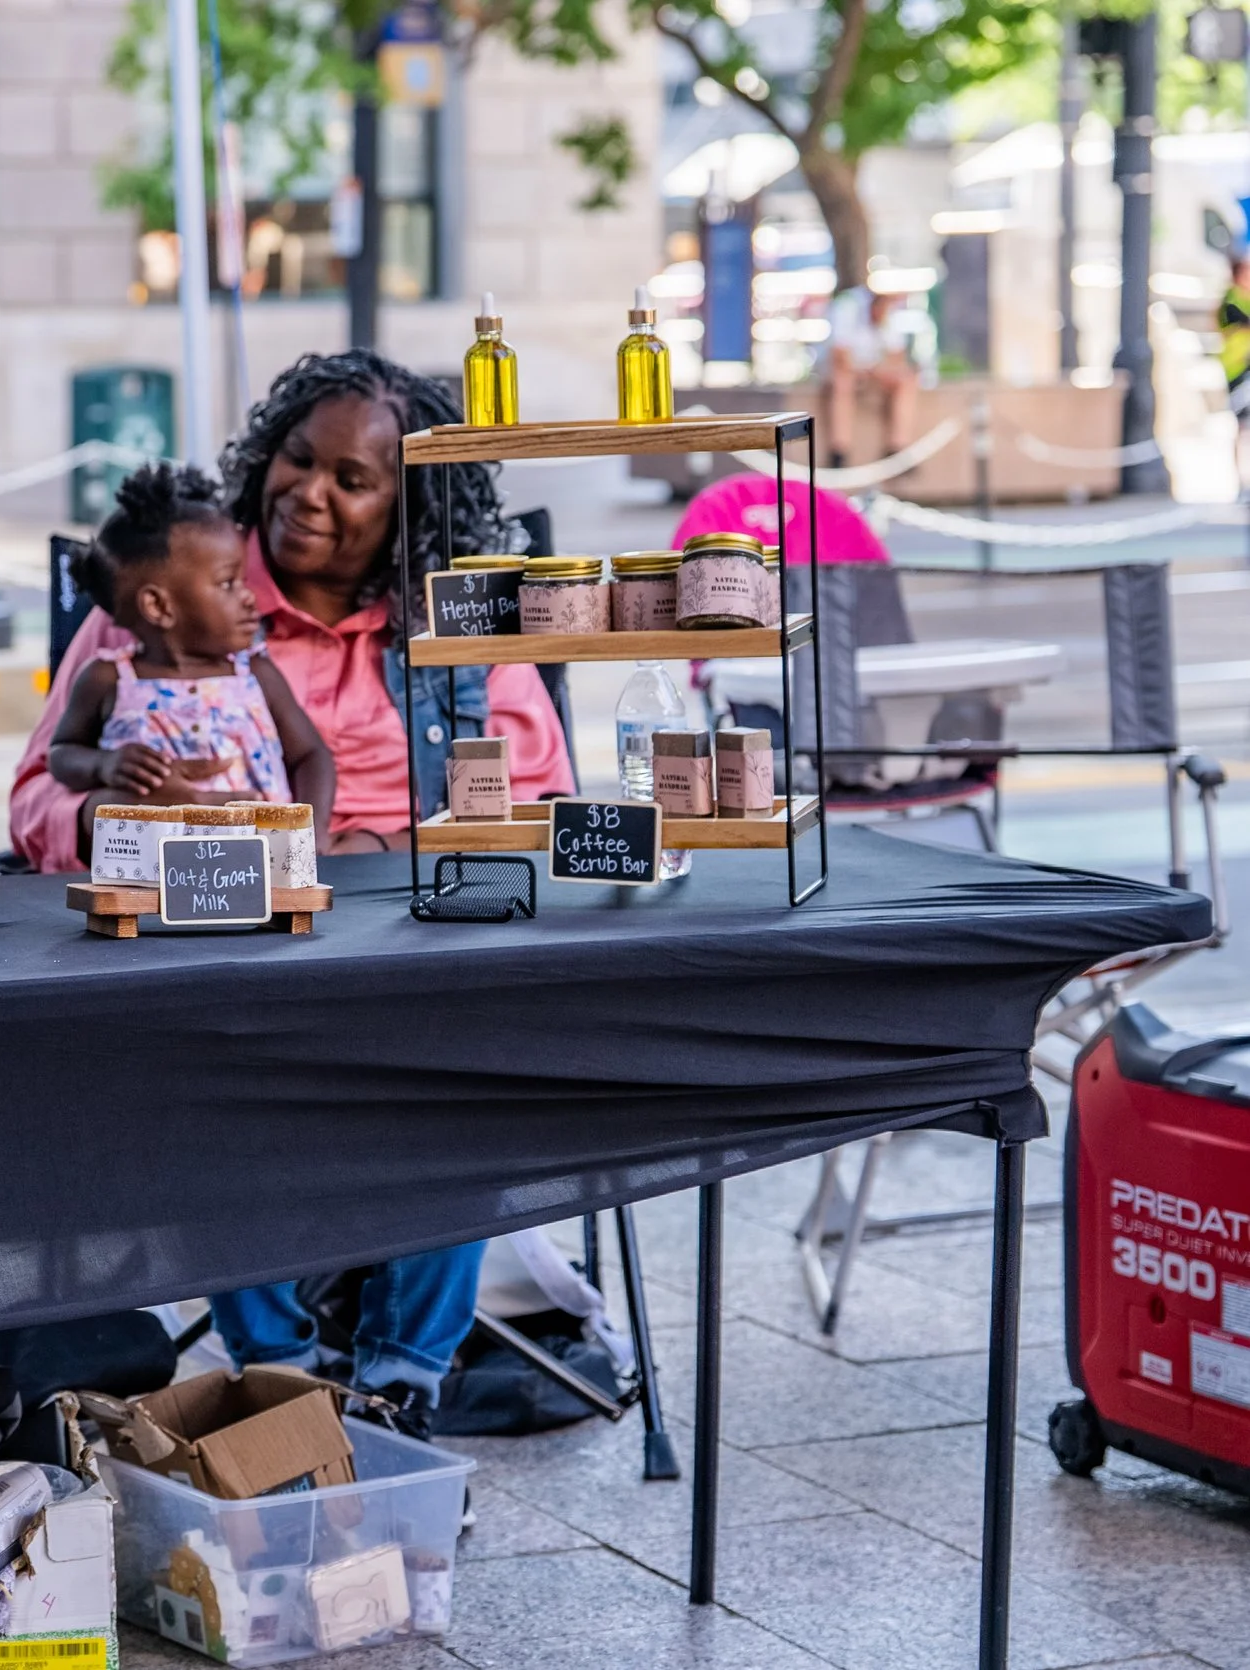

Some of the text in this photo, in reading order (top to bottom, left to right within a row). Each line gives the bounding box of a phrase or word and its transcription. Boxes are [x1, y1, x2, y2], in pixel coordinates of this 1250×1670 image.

[463, 573, 488, 594] $7
[711, 585, 749, 594] HANDMADE
[715, 576, 748, 586] NATURAL
[441, 598, 494, 621] Herbal
[524, 615, 553, 623] HANDMADE
[460, 618, 496, 636] Salt
[471, 776, 502, 784] NATURAL
[661, 773, 688, 782] NATURAL
[721, 767, 740, 775] NATURAL
[659, 782, 690, 791] HANDMADE
[587, 804, 620, 829] $8
[108, 838, 138, 846] NATURAL
[195, 841, 226, 860] $12
[556, 828, 630, 854] Coffee
[104, 846, 141, 856] HANDMADE
[568, 854, 649, 874] Scrub Bar
[167, 865, 259, 892] Oat & Goat
[192, 893, 230, 913] Milk
[1110, 1178, 1250, 1243] PREDAT
[1111, 1213, 1164, 1241] SUPER
[1165, 1230, 1213, 1255] QUIET
[1112, 1235, 1216, 1301] 3500
